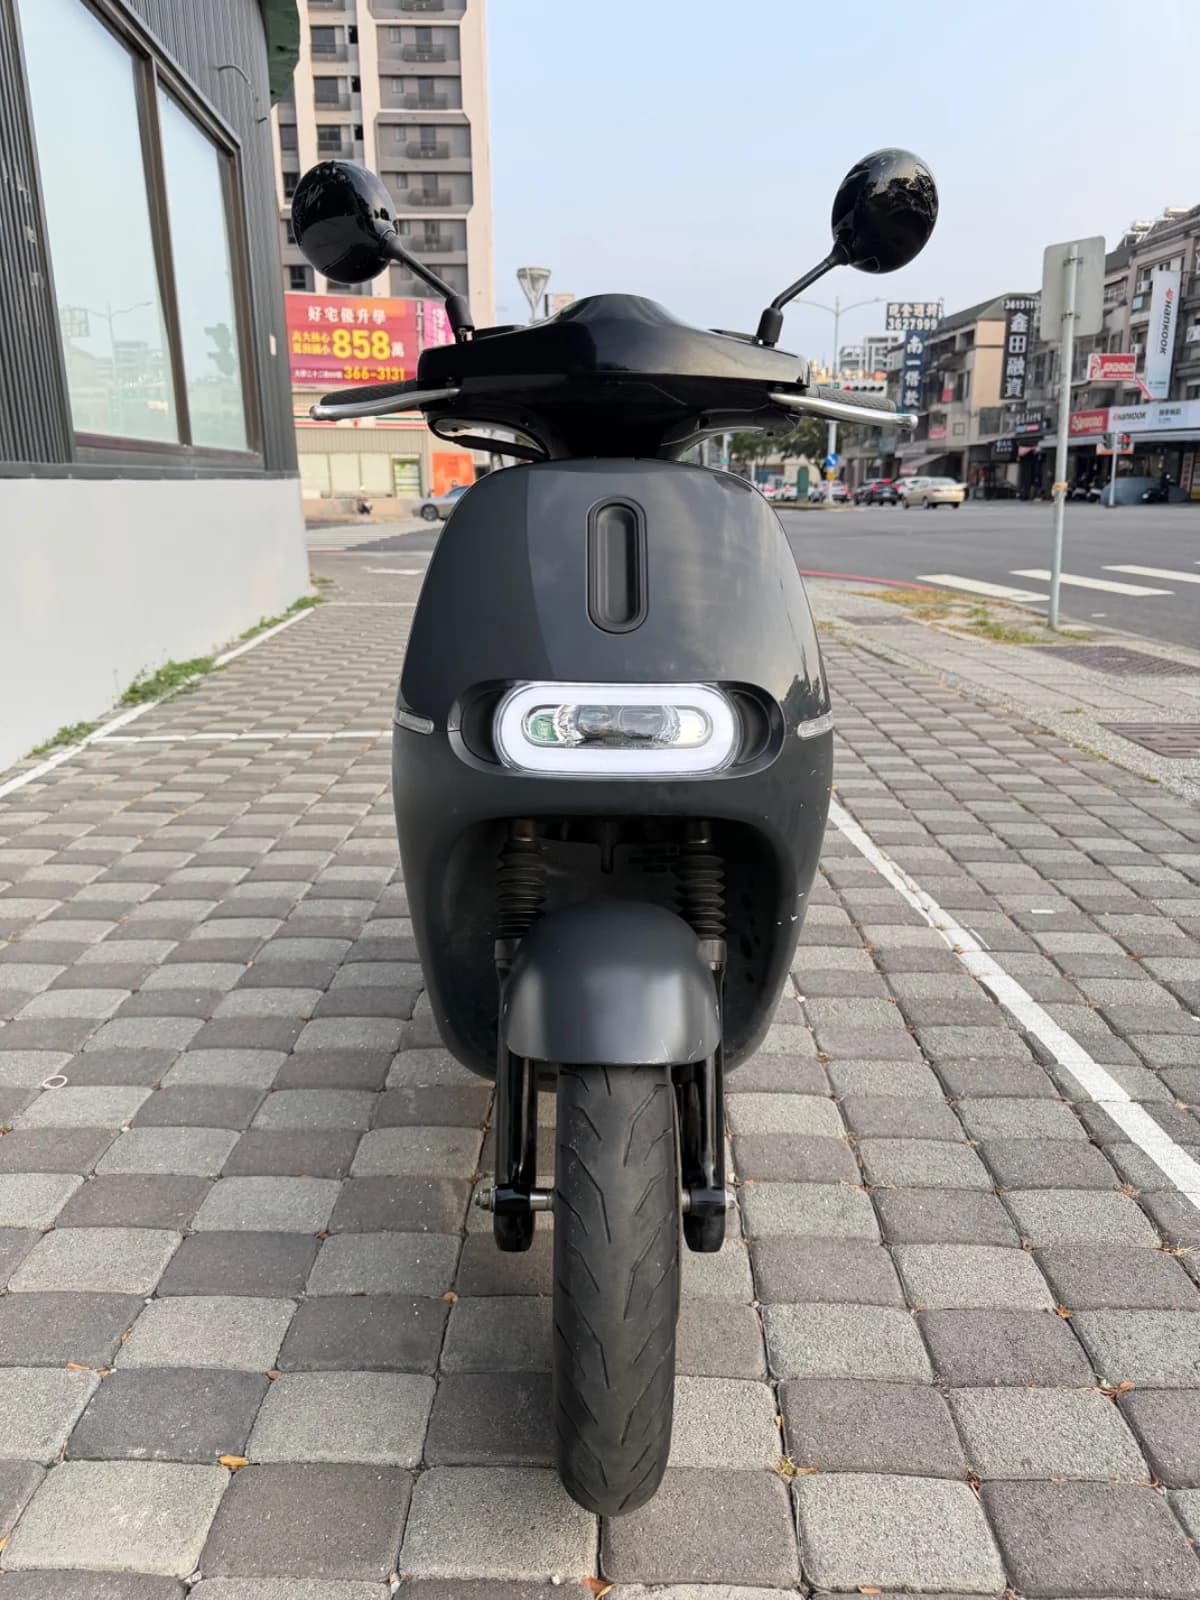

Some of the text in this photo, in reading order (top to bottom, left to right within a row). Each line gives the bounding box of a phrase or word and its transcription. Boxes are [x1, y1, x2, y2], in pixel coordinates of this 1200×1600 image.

[344, 366, 405, 381] 366-3131
[1005, 312, 1028, 398] 鑫田融資
